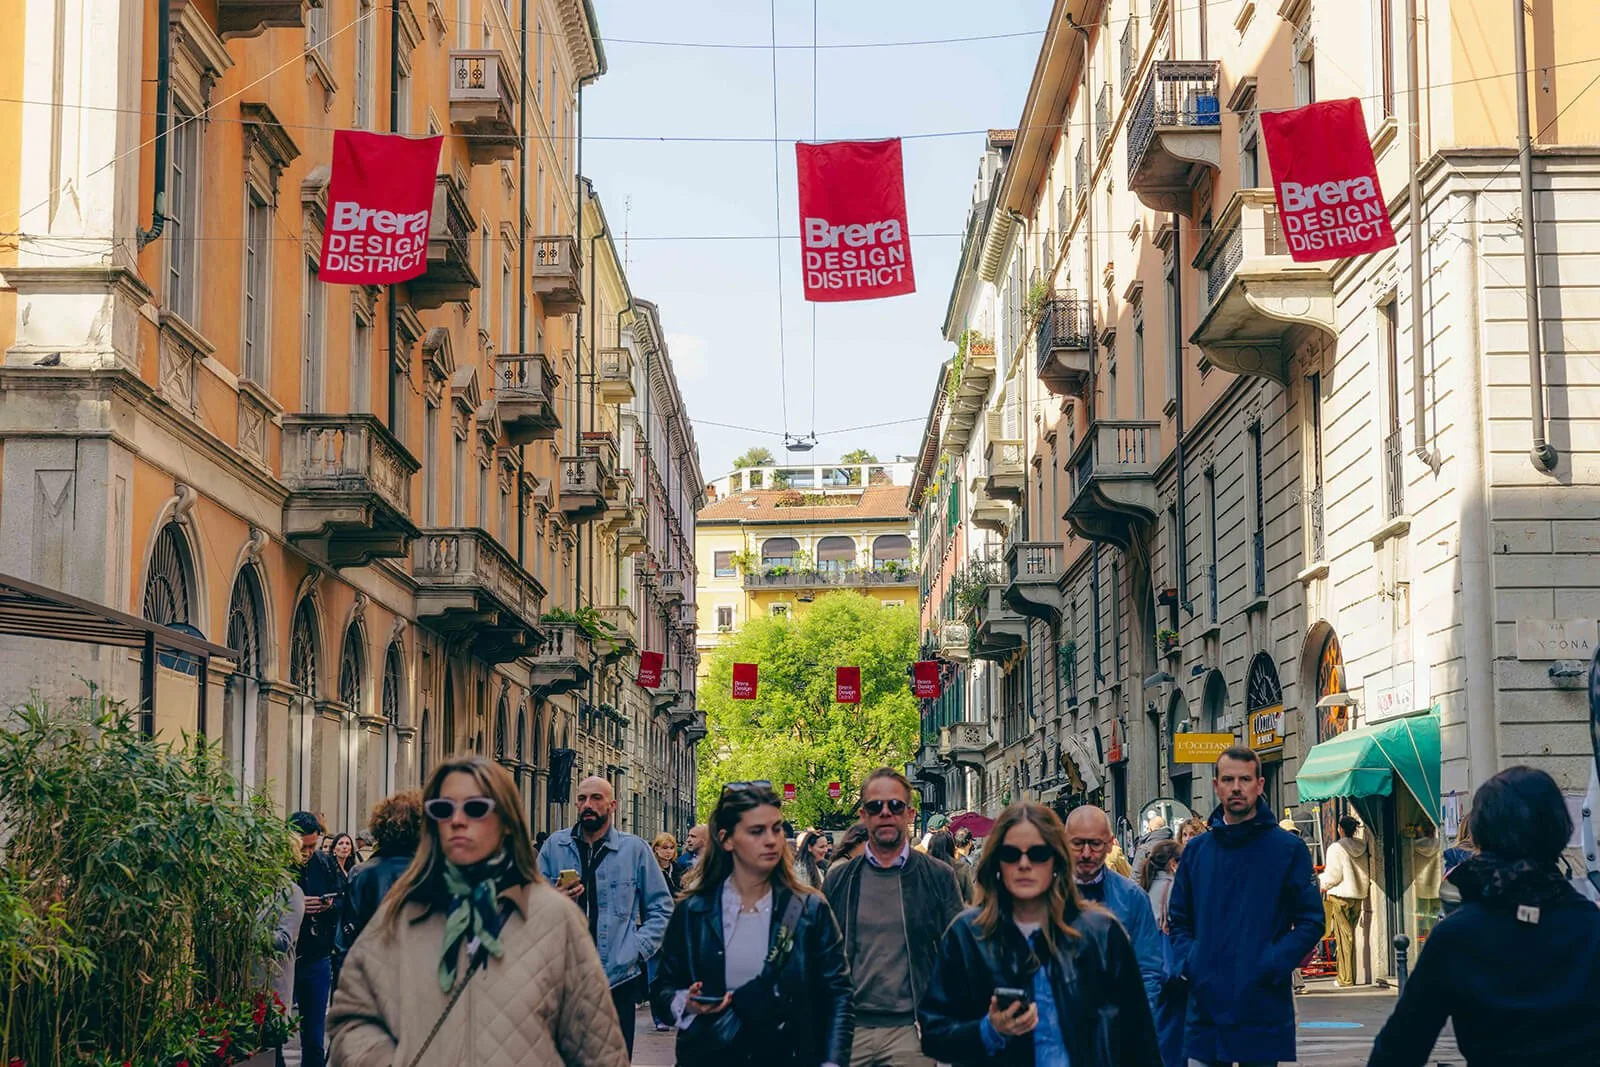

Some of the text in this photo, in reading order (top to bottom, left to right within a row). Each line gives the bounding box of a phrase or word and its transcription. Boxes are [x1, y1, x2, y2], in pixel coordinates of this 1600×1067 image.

[1280, 176, 1376, 212] Brera
[332, 201, 429, 235] Brera
[1286, 200, 1382, 233] DESIGN
[329, 231, 426, 255] DESIGN
[805, 217, 902, 248] Brera
[1290, 219, 1383, 252] DISTRICT
[326, 248, 424, 273] DISTRICT
[806, 244, 905, 270] DESIGN
[807, 264, 905, 289] DISTRICT
